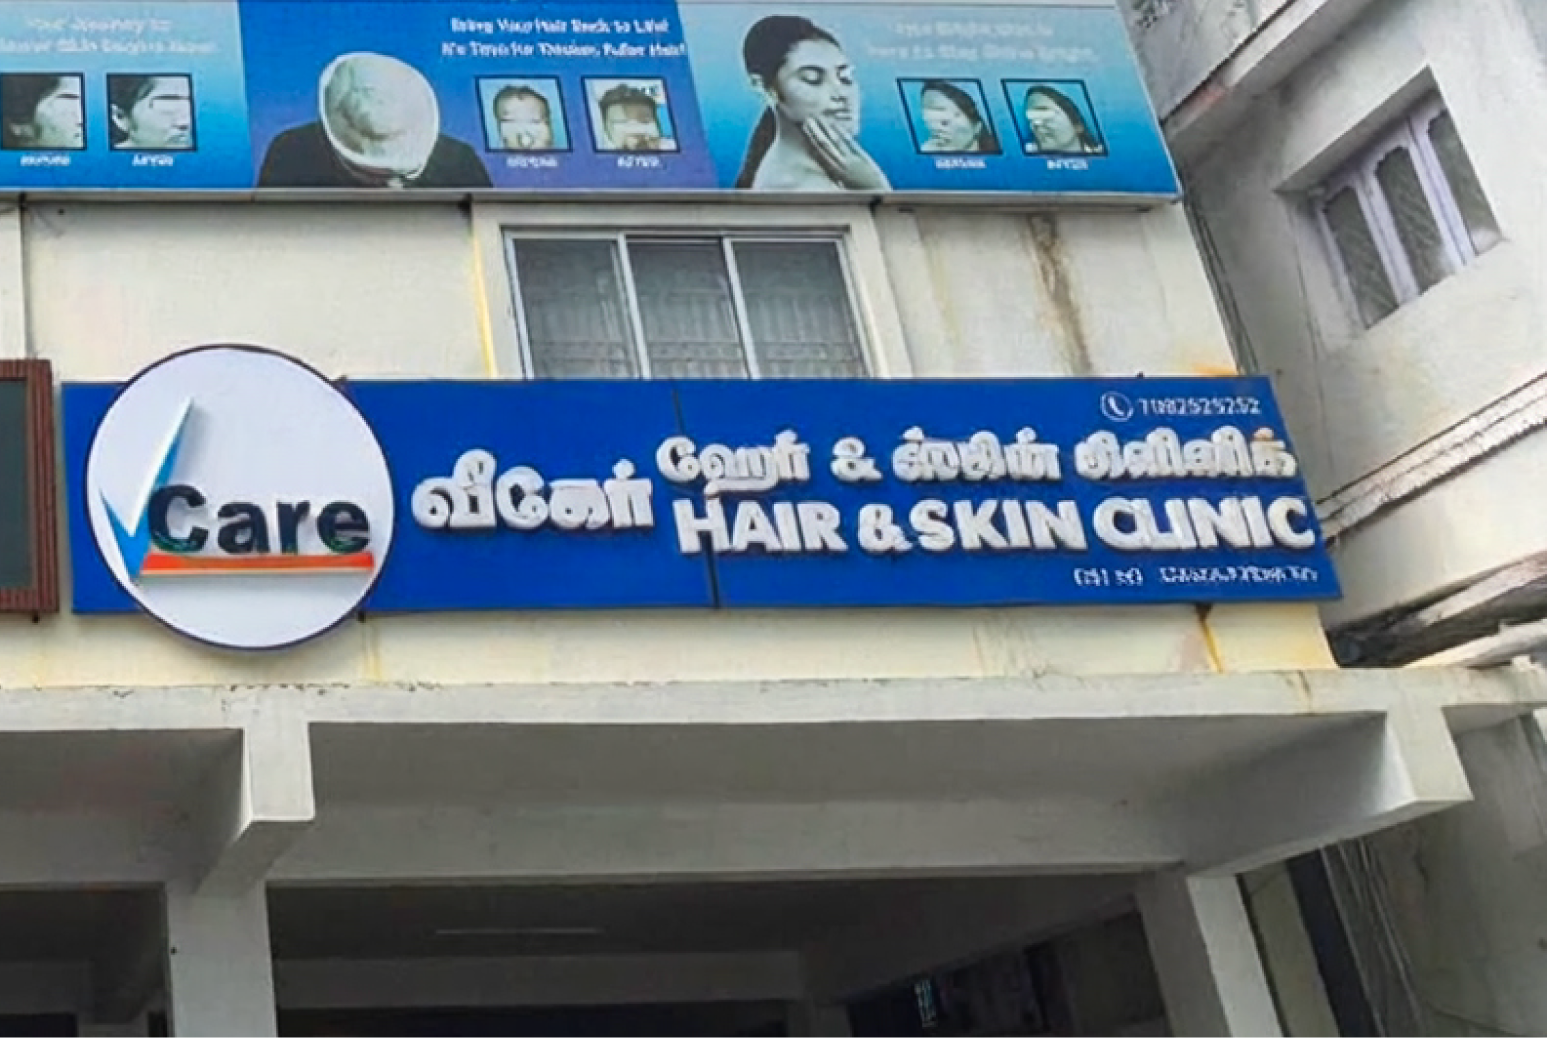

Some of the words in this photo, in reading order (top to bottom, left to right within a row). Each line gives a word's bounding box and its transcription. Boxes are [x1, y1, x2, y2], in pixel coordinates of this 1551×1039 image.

[831, 437, 883, 481] &
[672, 499, 849, 555] HAIR
[1094, 496, 1316, 550] CLINIC
